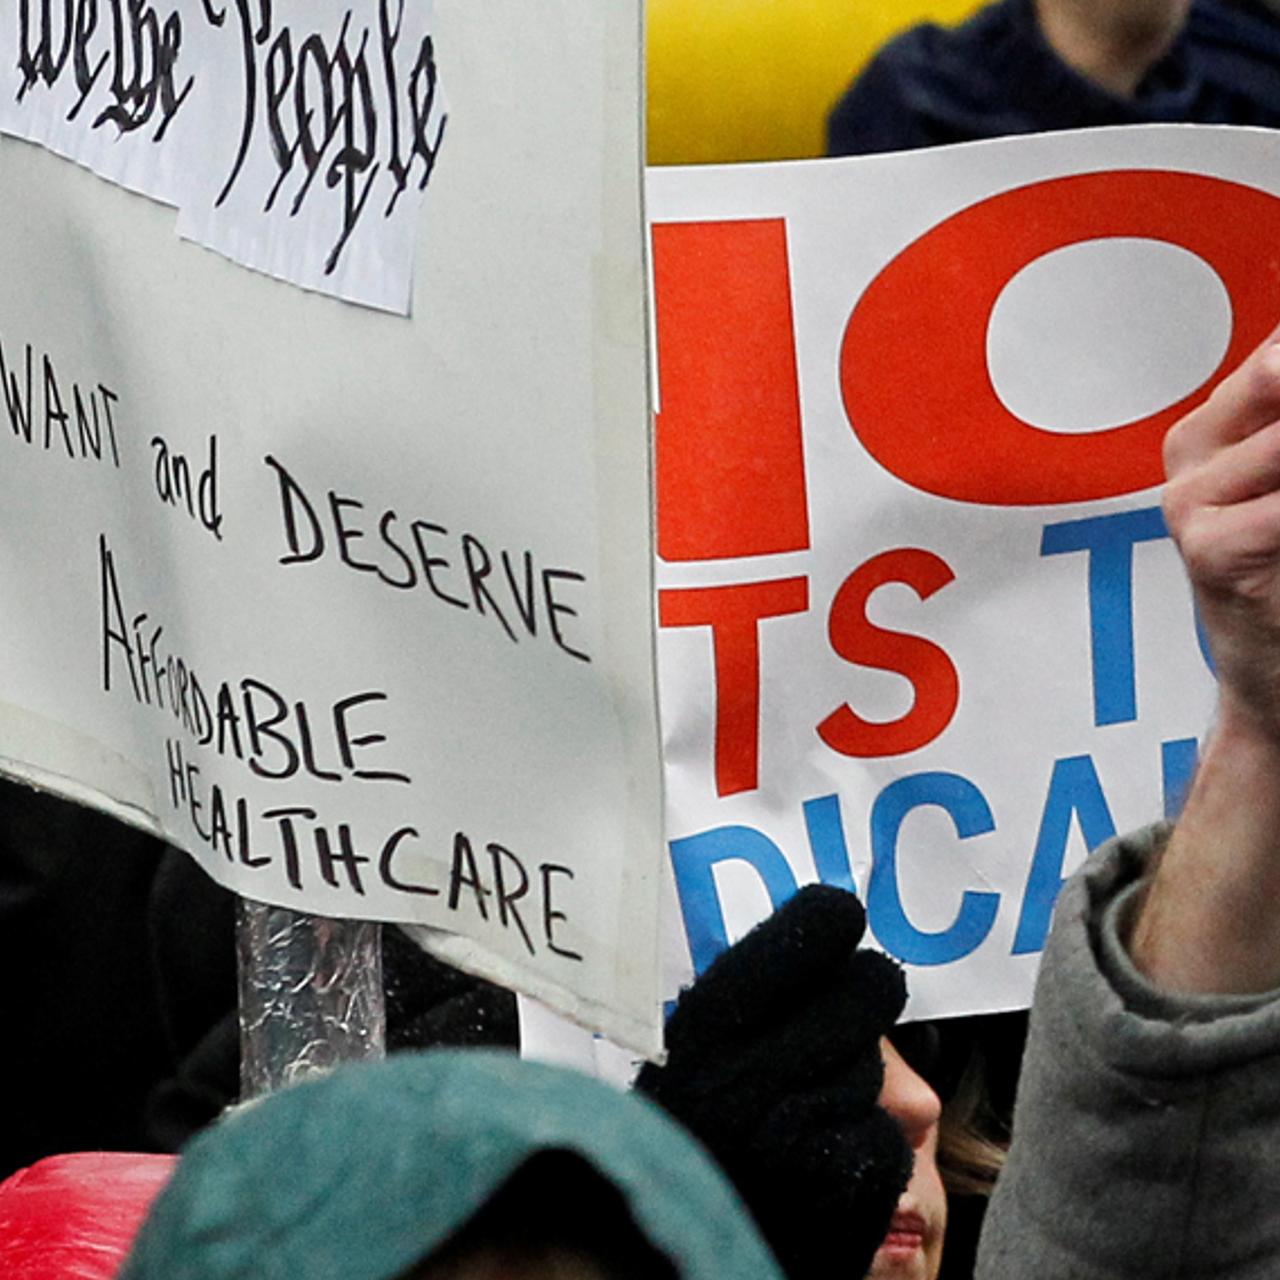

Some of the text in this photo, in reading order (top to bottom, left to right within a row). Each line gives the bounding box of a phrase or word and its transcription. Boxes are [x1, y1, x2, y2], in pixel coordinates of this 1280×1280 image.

[0, 342, 592, 663] WANT and DESERVE
[100, 533, 412, 785] AFFORDABLE
